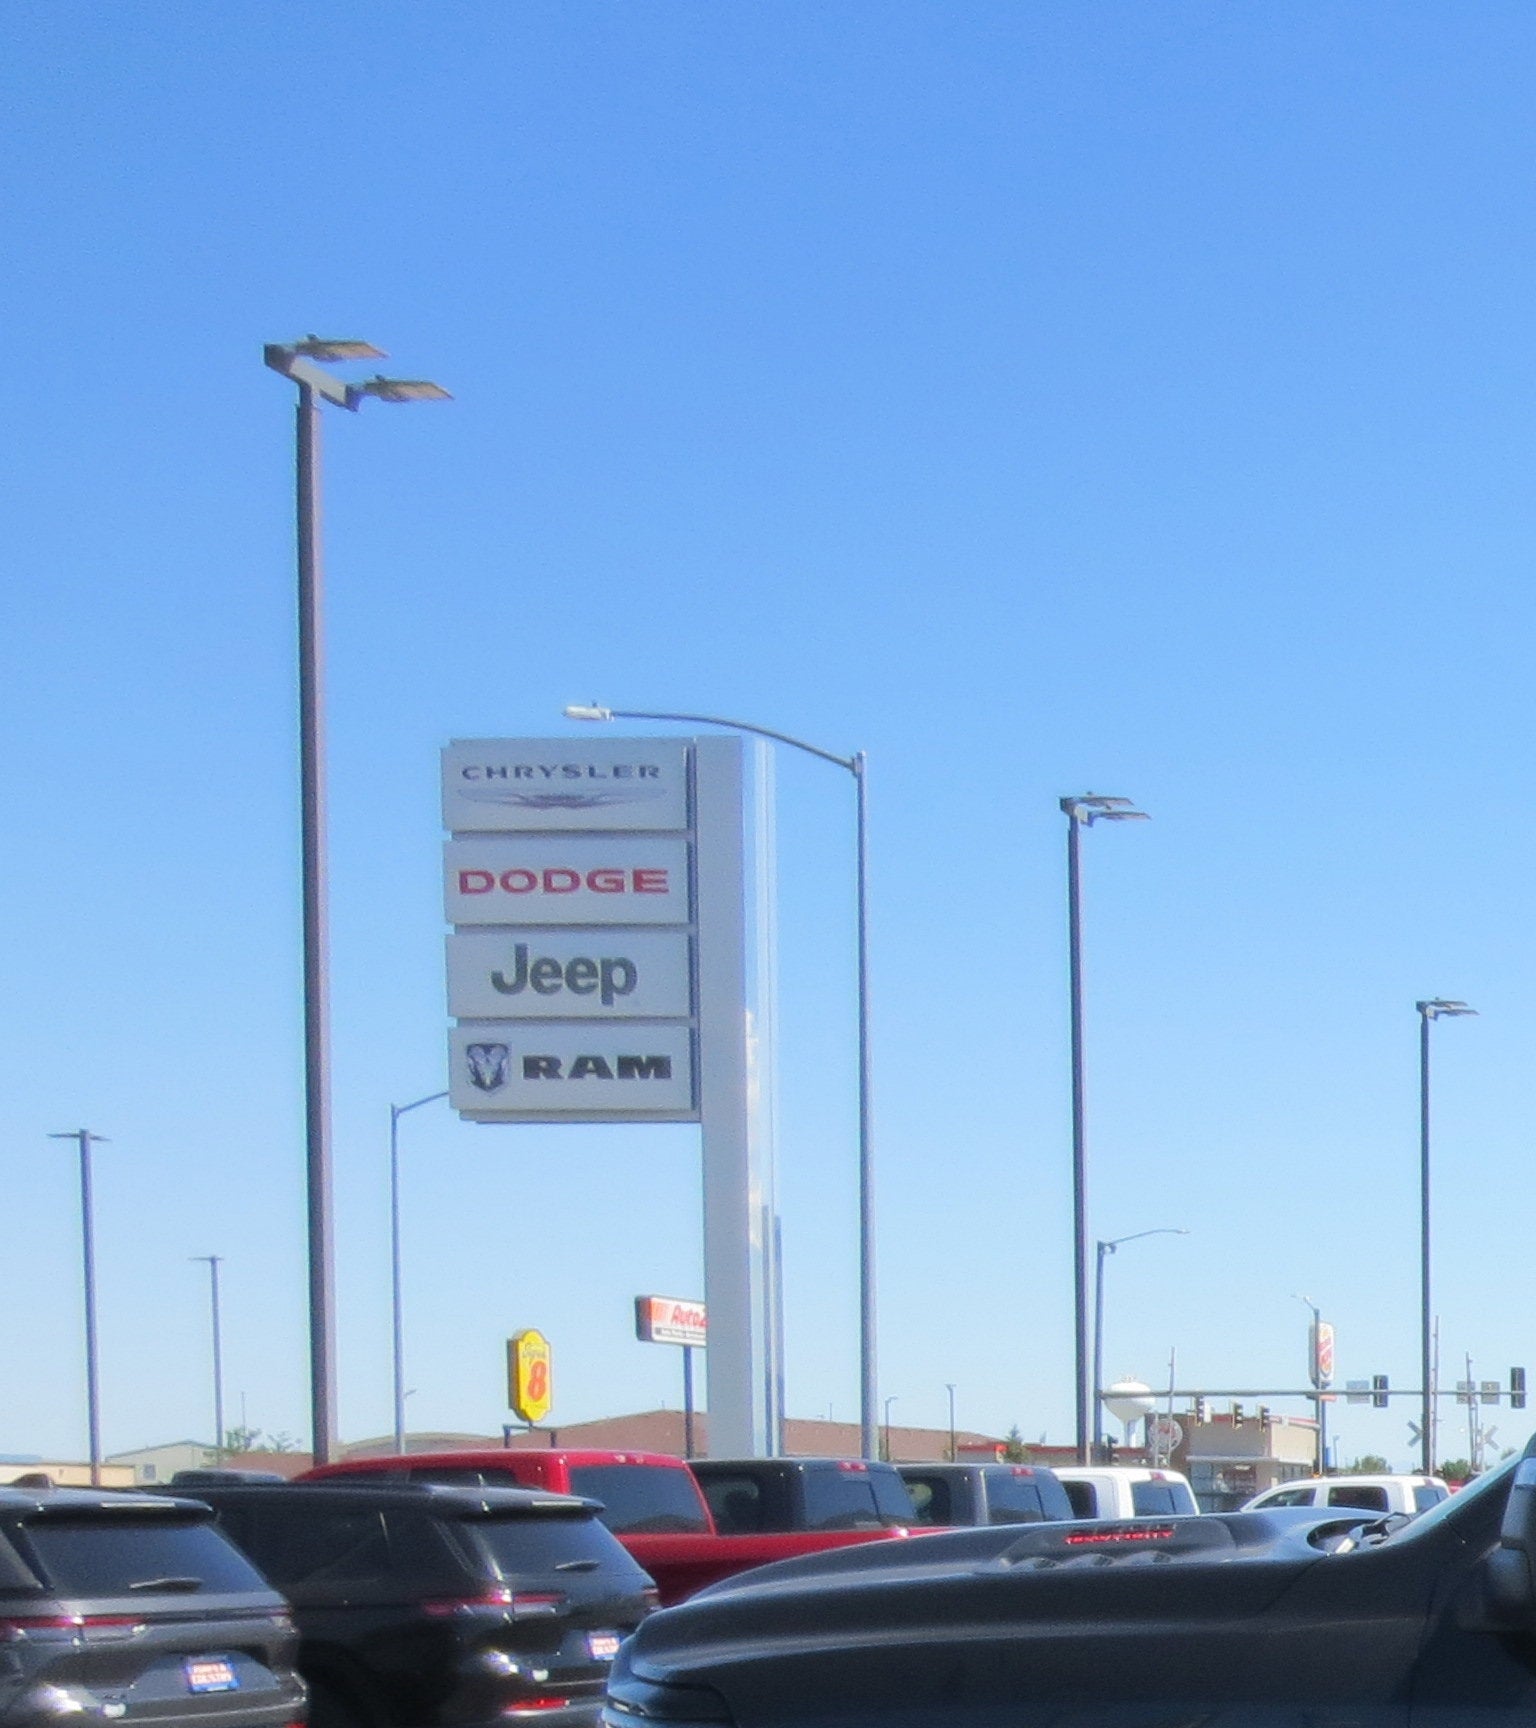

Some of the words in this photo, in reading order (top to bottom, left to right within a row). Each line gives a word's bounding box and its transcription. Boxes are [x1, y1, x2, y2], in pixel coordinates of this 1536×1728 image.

[461, 764, 661, 781] CHRYSLER
[458, 868, 670, 895] DODGE
[490, 943, 638, 1007] Jeep
[522, 1055, 673, 1080] RAM
[528, 1360, 547, 1402] 8
